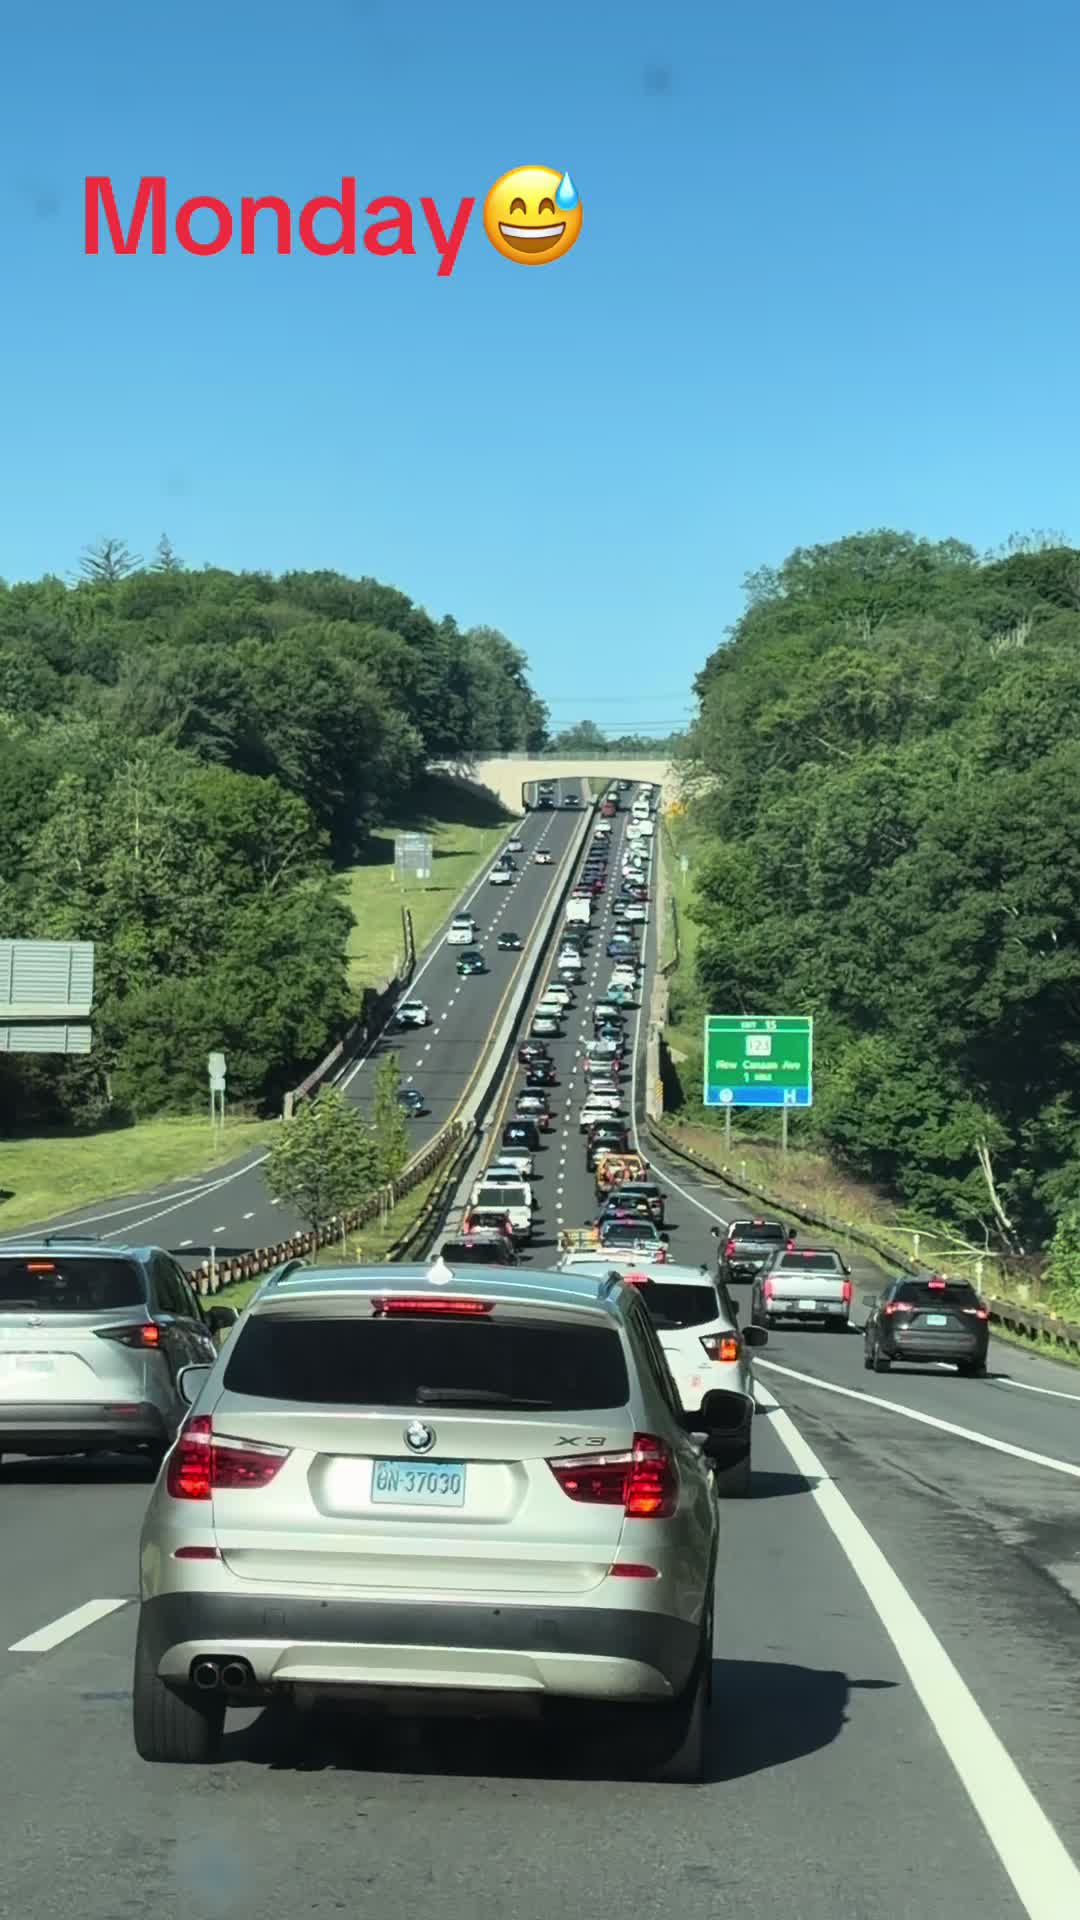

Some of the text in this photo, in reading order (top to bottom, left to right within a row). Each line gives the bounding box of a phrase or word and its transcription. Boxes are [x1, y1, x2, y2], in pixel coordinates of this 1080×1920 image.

[765, 1020, 777, 1030] 15
[715, 1060, 801, 1070] New Canaan Ave
[743, 1072, 750, 1082] 1
[783, 1089, 797, 1103] H
[553, 1435, 607, 1447] X3
